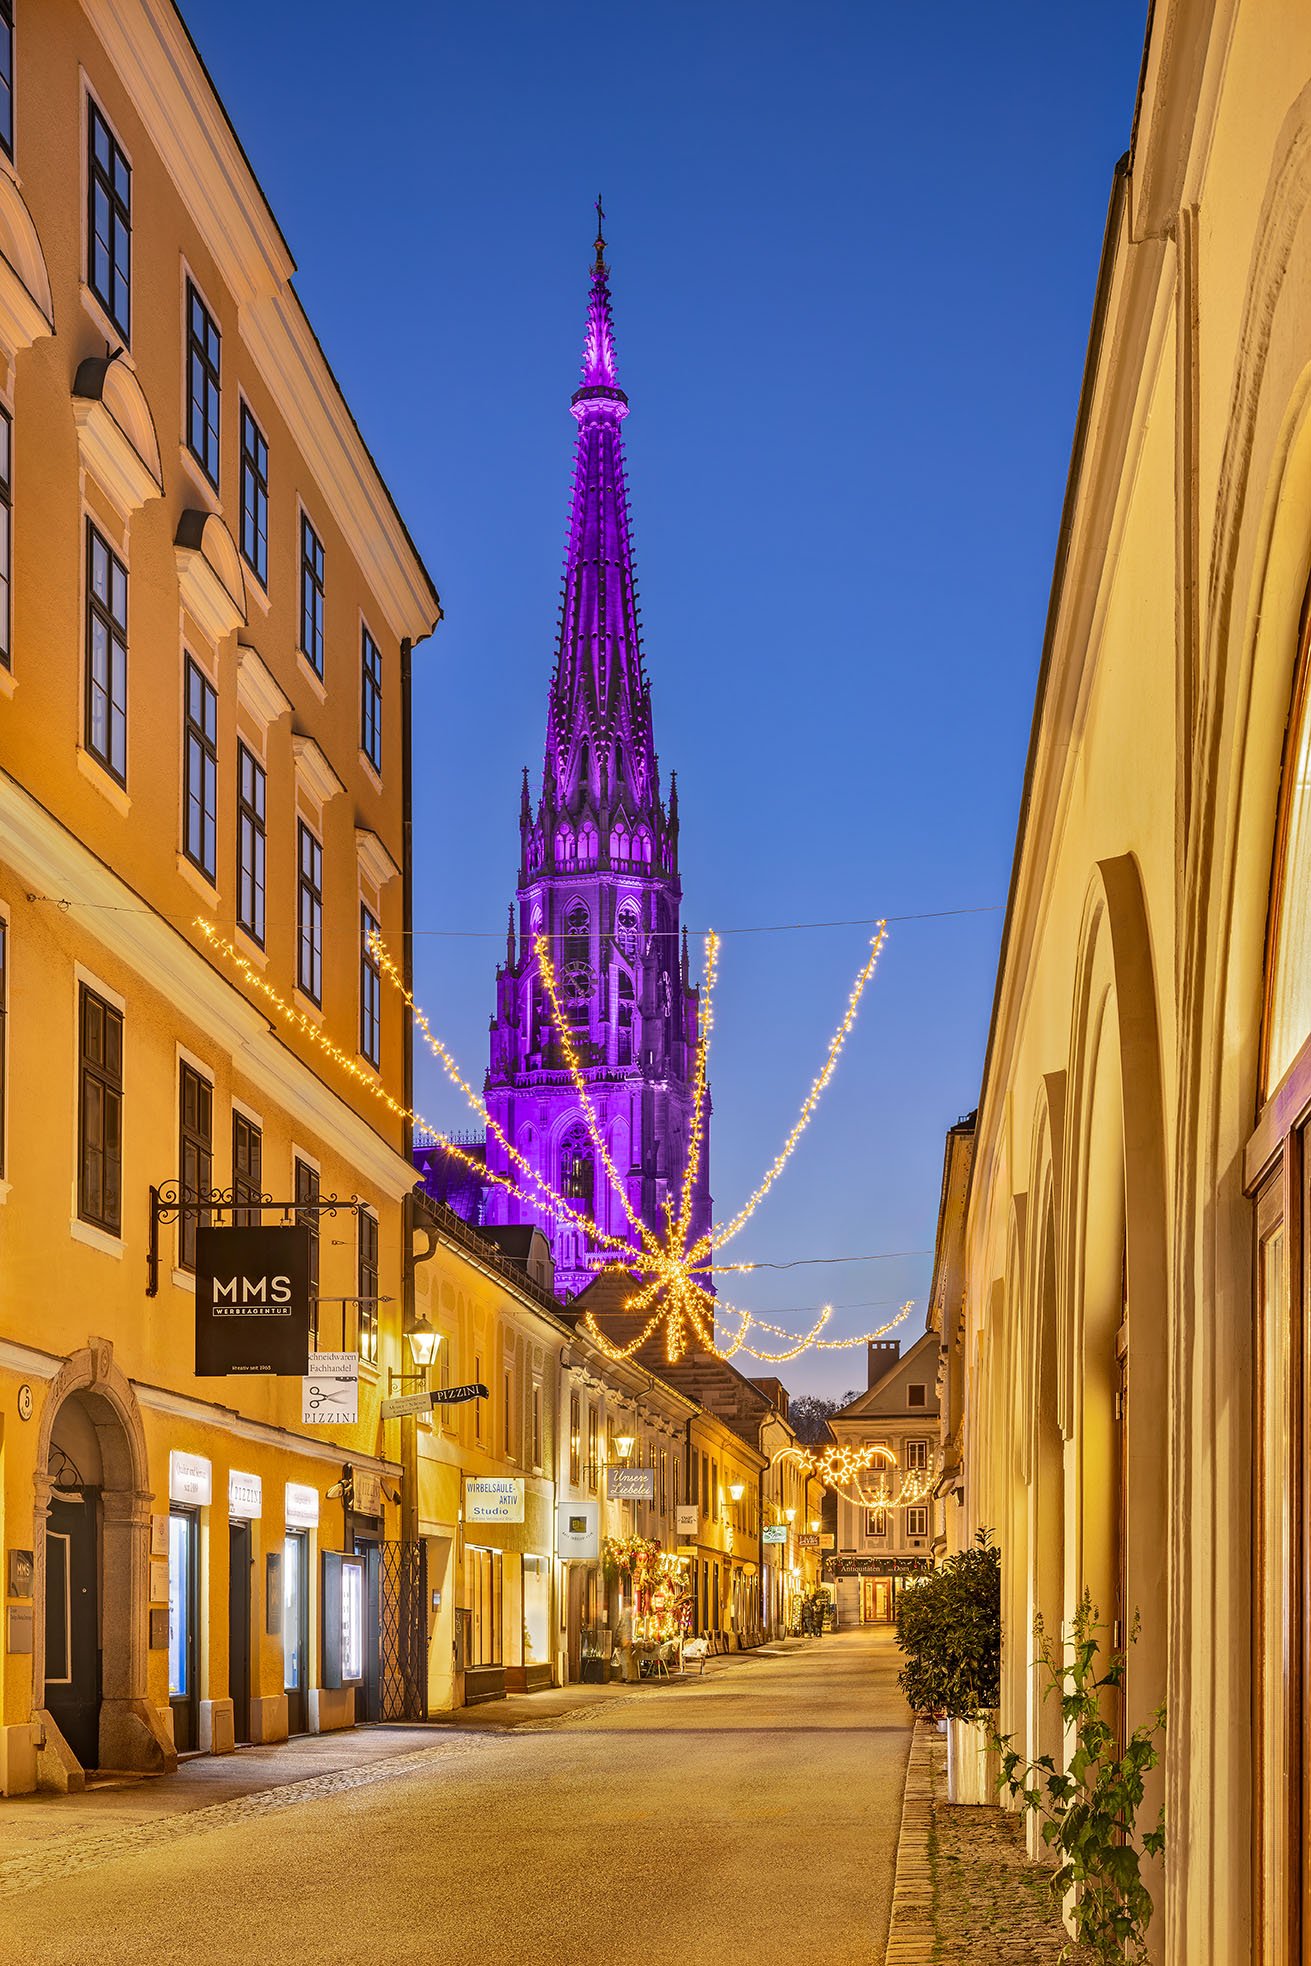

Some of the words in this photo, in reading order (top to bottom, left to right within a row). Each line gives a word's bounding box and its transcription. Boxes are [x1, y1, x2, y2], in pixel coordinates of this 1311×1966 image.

[213, 1275, 292, 1303] MMS
[310, 1364, 352, 1373] Fachhandel
[25, 1388, 30, 1408] 5
[437, 1385, 480, 1401] PIZZINI
[304, 1413, 357, 1424] PIZZINI
[613, 1469, 649, 1482] Unsere
[610, 1483, 651, 1495] Liebelei
[499, 1495, 518, 1505] AKTIV
[473, 1507, 509, 1515] Studio
